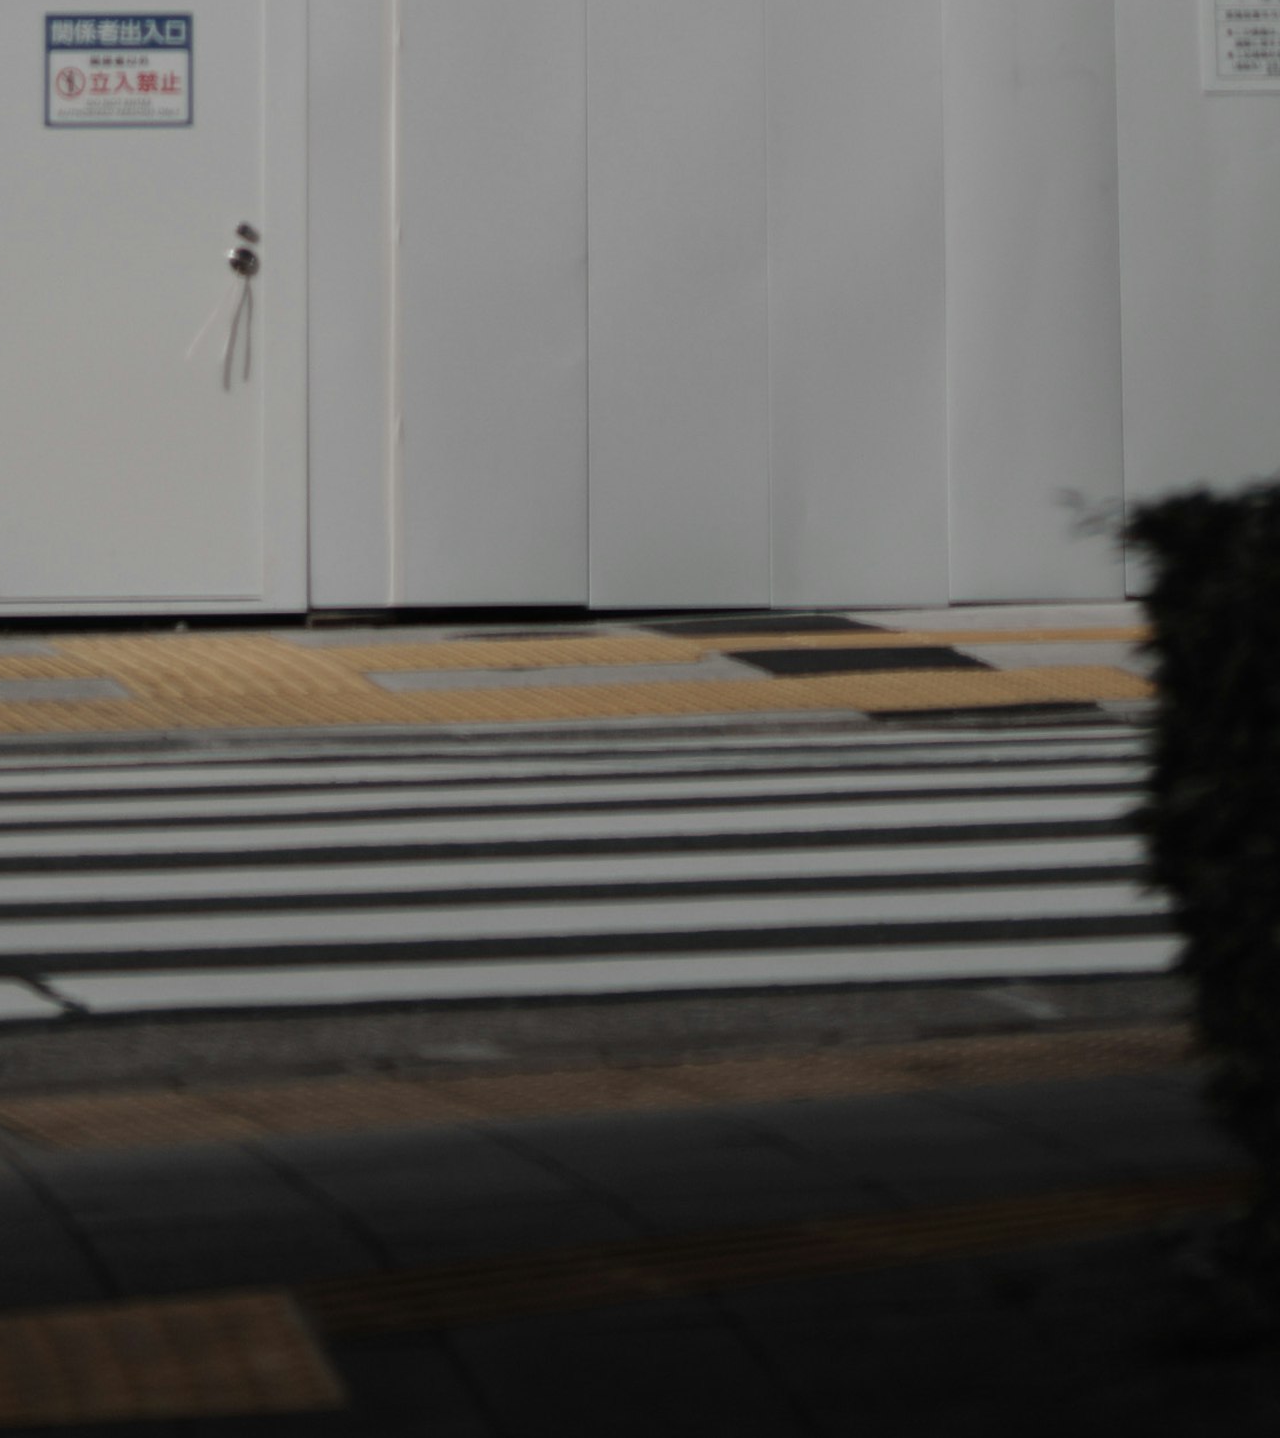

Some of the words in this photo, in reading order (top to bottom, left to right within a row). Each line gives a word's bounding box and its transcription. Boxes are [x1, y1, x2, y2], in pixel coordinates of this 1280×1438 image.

[51, 19, 186, 44] 関係者出入口
[89, 70, 181, 95] 立入禁止
